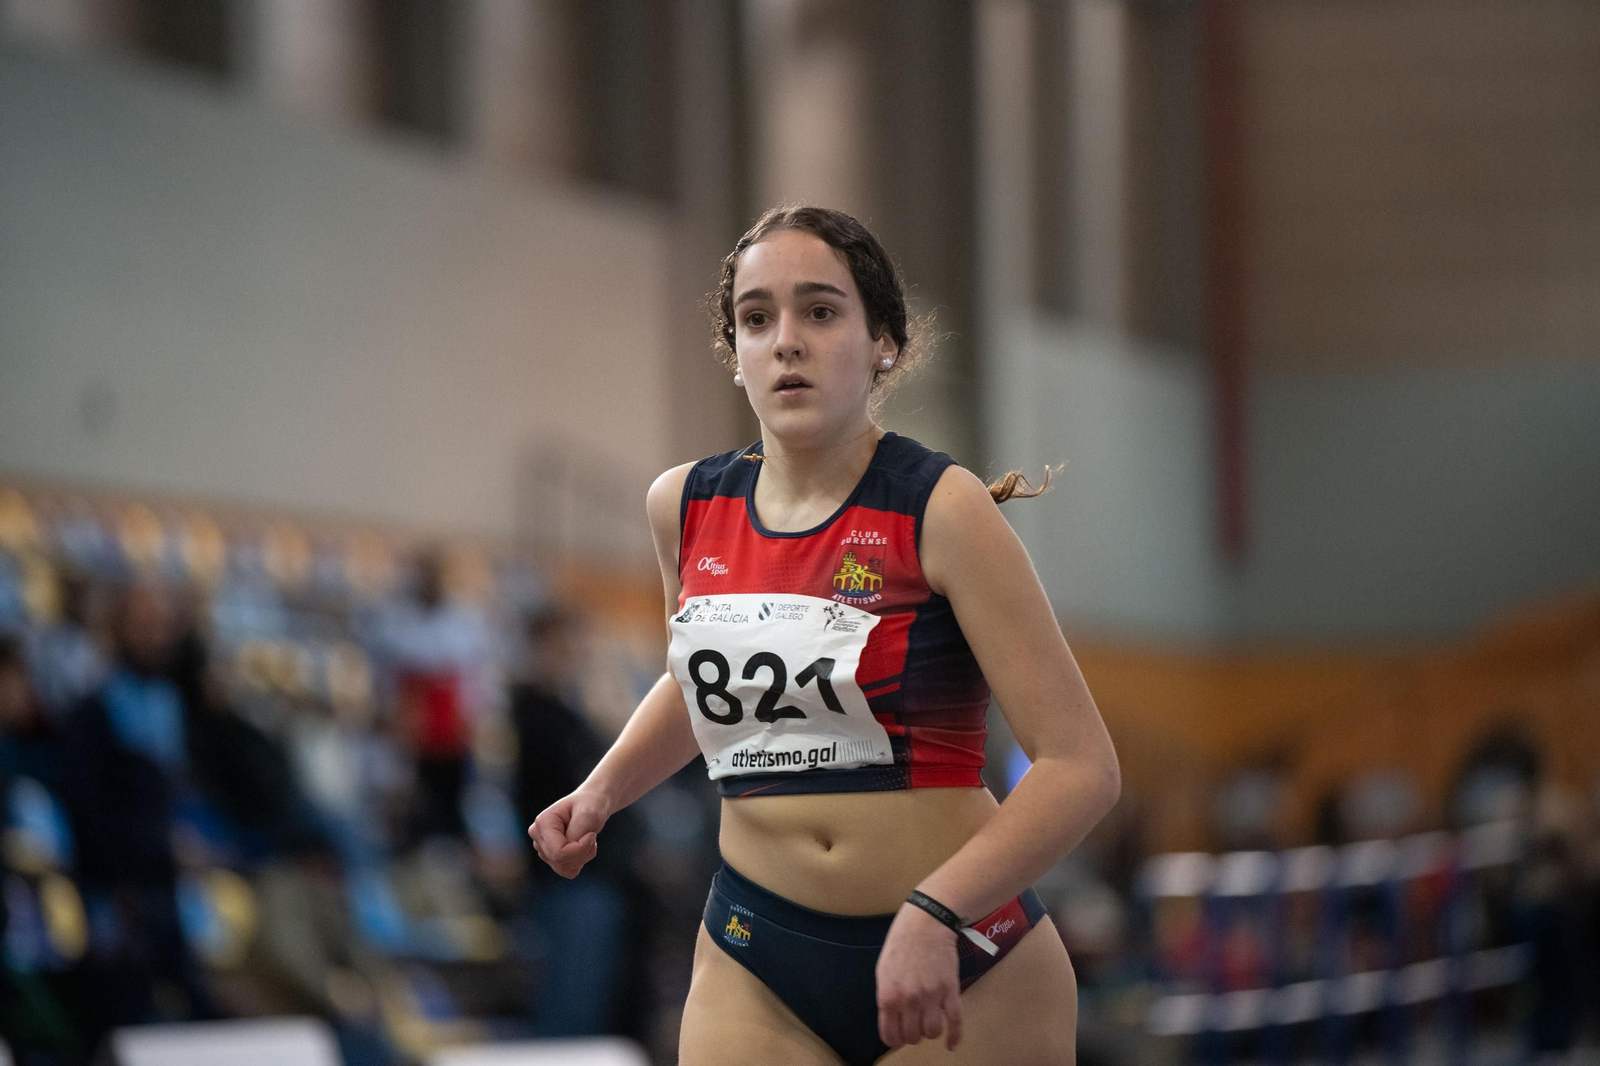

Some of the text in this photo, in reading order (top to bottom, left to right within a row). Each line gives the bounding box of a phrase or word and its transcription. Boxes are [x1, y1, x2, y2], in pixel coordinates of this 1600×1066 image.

[851, 530, 879, 538] CLUB
[831, 593, 882, 605] ATLETISMO
[777, 603, 810, 613] DEPORTE
[709, 613, 749, 623] GALICIA
[775, 612, 804, 621] GALEGO
[688, 649, 847, 725] 821
[732, 741, 837, 768] atletismo.gal
